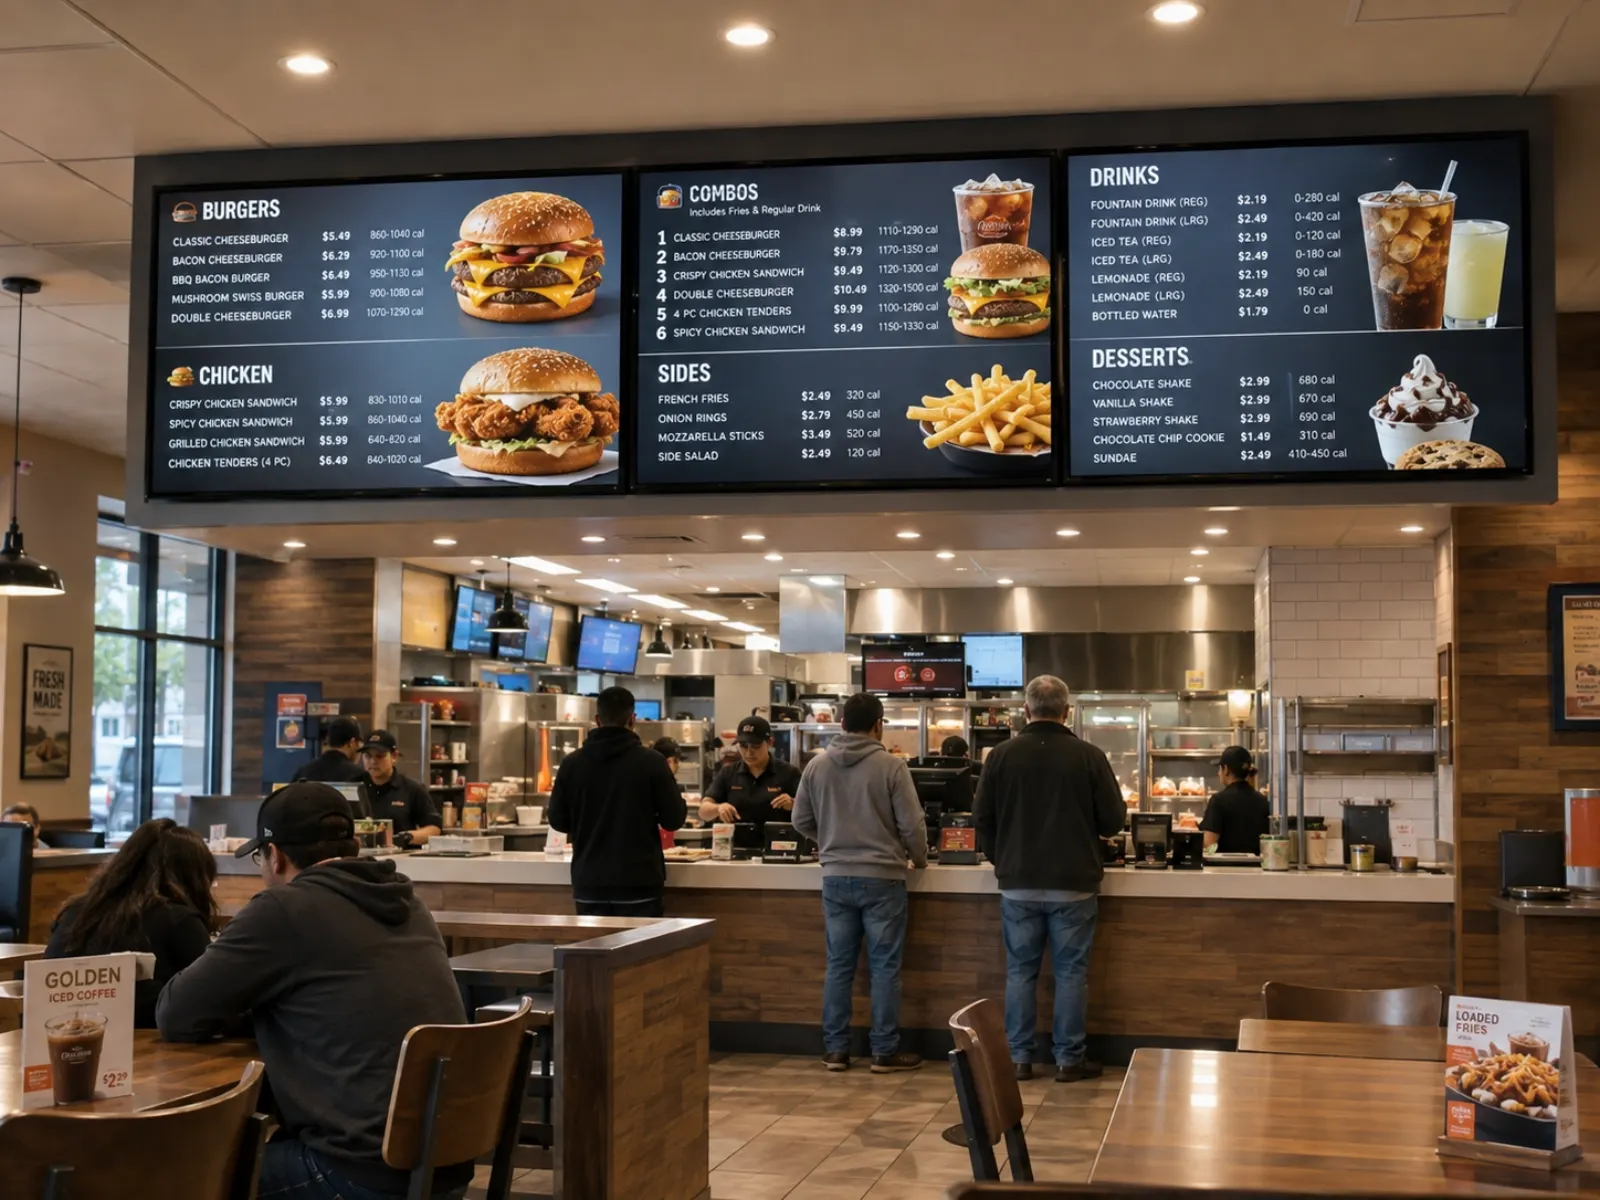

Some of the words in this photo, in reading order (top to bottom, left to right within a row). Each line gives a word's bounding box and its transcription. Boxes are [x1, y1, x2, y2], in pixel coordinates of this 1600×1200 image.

[1091, 166, 1159, 186] DRINKS
[690, 183, 758, 202] COMBOS
[1091, 200, 1142, 209] FOUNTAIN
[1146, 198, 1176, 207] DRINK
[1180, 197, 1207, 207] (REG)
[1238, 195, 1266, 205] $2.19
[203, 199, 280, 220] BURGERS
[690, 207, 726, 216] Includes
[729, 207, 750, 215] Fries
[752, 206, 759, 214] &
[762, 205, 795, 216] Regular
[798, 204, 821, 213] Drink
[1092, 218, 1142, 228] FOUNTAIN
[1146, 217, 1176, 226] DRINK
[1180, 215, 1208, 227] (LRG)
[1238, 214, 1267, 224] $2.49
[173, 236, 212, 246] CLASSIC
[214, 234, 288, 245] CHEESEBURGER
[323, 231, 350, 241] $5.49
[658, 231, 666, 245] 1
[674, 233, 711, 242] CLASSIC
[713, 230, 780, 241] CHEESEBURGER
[834, 228, 862, 237] $8.99
[1092, 238, 1115, 247] ICED
[1119, 237, 1138, 246] TEA
[1142, 236, 1171, 246] (REG)
[1238, 232, 1267, 243] $2.19
[1326, 230, 1340, 239] cal
[173, 256, 205, 265] BACON
[209, 253, 282, 264] CHEESEBURGER
[323, 251, 350, 261] $6.29
[412, 248, 424, 257] cal
[657, 250, 666, 264] 2
[674, 252, 706, 261] BACON
[709, 249, 780, 260] CHEESEBURGER
[834, 246, 862, 256] $9.79
[1092, 256, 1115, 265] ICED
[1119, 255, 1138, 264] TEA
[1142, 254, 1171, 265] (LRG)
[1238, 251, 1268, 261] $2.49
[173, 275, 192, 285] BBQ
[195, 274, 228, 284] BACON
[232, 273, 270, 283] BURGER
[322, 270, 349, 280] $6.49
[657, 269, 666, 283] 3
[674, 271, 706, 280] CRISPY
[709, 270, 750, 279] CHICKEN
[753, 268, 804, 277] SANDWICH
[834, 266, 862, 276] $9.49
[925, 263, 938, 272] cal
[1092, 273, 1149, 284] LEMONADE
[1155, 273, 1184, 283] (REG)
[1239, 270, 1268, 280] $2.19
[172, 294, 229, 303] MUSHROOM
[233, 292, 262, 302] SWISS
[265, 291, 304, 301] BURGER
[322, 290, 349, 299] $5.99
[656, 288, 667, 302] 4
[674, 290, 714, 299] DOUBLE
[717, 287, 793, 298] CHEESEBURGER
[834, 285, 867, 295] $10.49
[1092, 292, 1150, 302] LEMONADE
[1155, 291, 1185, 301] (LRG)
[1239, 288, 1268, 299] $2.49
[1298, 286, 1315, 295] 150
[1319, 286, 1333, 295] cal
[172, 313, 211, 323] DOUBLE
[214, 310, 291, 321] CHEESEBURGER
[322, 309, 349, 319] $6.99
[657, 308, 666, 321] 5
[684, 309, 696, 318] PC
[699, 308, 743, 317] CHICKEN
[747, 306, 791, 316] TENDERS
[834, 304, 862, 314] $9.99
[1092, 311, 1139, 321] BOTTLED
[1142, 309, 1177, 319] WATER
[1239, 307, 1268, 317] $1.79
[657, 326, 666, 340] 6
[674, 328, 702, 337] SPICY
[705, 327, 748, 336] CHICKEN
[752, 325, 805, 335] SANDWICH
[834, 323, 863, 333] $9.49
[1093, 347, 1189, 368] DESSERTS
[200, 365, 272, 385] CHICKEN
[659, 363, 710, 383] SIDES
[1093, 380, 1154, 390] CHOCOLATE
[1158, 379, 1191, 388] SHAKE
[1240, 376, 1270, 387] $2.99
[170, 400, 201, 409] CRISPY
[204, 399, 244, 408] CHICKEN
[247, 398, 297, 407] SANDWICH
[320, 396, 348, 406] $5.99
[659, 395, 698, 404] FRENCH
[702, 394, 729, 403] FRIES
[802, 391, 830, 401] $2.49
[847, 390, 864, 399] 320
[867, 390, 880, 399] cal
[1093, 399, 1136, 408] VANILLA
[1140, 397, 1173, 407] SHAKE
[1240, 395, 1270, 405] $2.99
[170, 419, 196, 428] SPICY
[199, 419, 239, 428] CHICKEN
[242, 417, 293, 427] SANDWICH
[320, 416, 348, 426] $5.99
[658, 414, 692, 423] ONION
[696, 413, 727, 422] RINGS
[802, 410, 830, 420] $2.79
[847, 410, 864, 419] 450
[867, 410, 880, 418] cal
[1094, 416, 1161, 426] STRAWBERRY
[1165, 415, 1198, 425] SHAKE
[1241, 413, 1270, 424] $2.99
[169, 439, 207, 448] GRILLED
[210, 438, 251, 447] CHICKEN
[254, 437, 304, 446] SANDWICH
[320, 435, 347, 445] $5.99
[408, 434, 420, 443] cal
[659, 432, 726, 442] MOZZARELLA
[729, 431, 764, 440] STICKS
[802, 430, 831, 439] $3.49
[1093, 434, 1155, 444] CHOCOLATE
[1159, 434, 1182, 443] CHIP
[1186, 433, 1224, 442] COOKIE
[1241, 432, 1270, 442] $1.49
[1300, 431, 1318, 440] 310
[1321, 430, 1335, 440] cal
[169, 458, 211, 468] CHICKEN
[214, 457, 258, 467] TENDERS
[262, 457, 271, 468] (4
[274, 457, 290, 467] PC)
[320, 456, 348, 465] $6.49
[658, 452, 681, 461] SIDE
[685, 451, 718, 460] SALAD
[802, 449, 831, 458] $2.49
[1094, 453, 1136, 463] SUNDAE
[1241, 450, 1271, 460] $2.49
[33, 670, 65, 689] FRESH
[33, 691, 62, 709] MADE
[46, 966, 121, 988] GOLDEN
[49, 991, 74, 1003] ICED
[76, 988, 117, 1000] COFFEE
[1456, 1010, 1499, 1024] LOADED
[1456, 1023, 1487, 1035] FRIES
